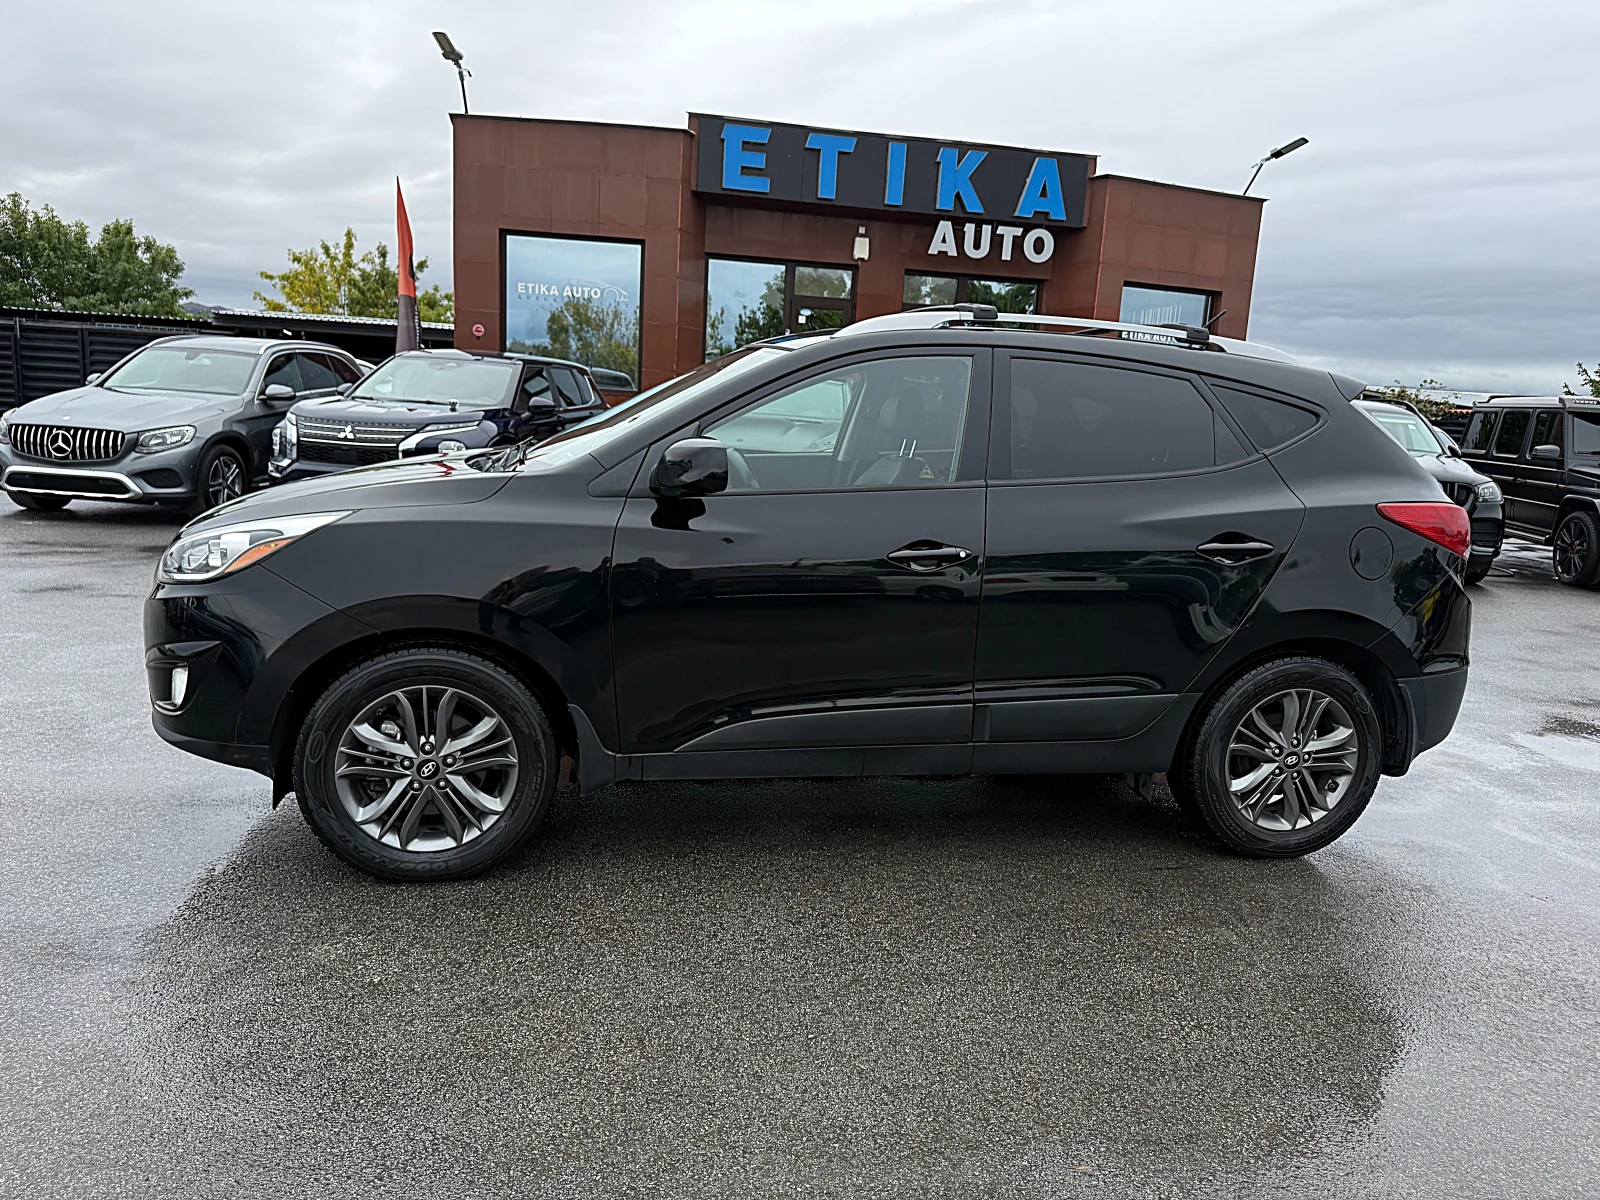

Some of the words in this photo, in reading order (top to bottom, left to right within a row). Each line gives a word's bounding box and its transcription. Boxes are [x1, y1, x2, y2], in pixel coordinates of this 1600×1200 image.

[720, 123, 1067, 221] ETIKA
[927, 220, 1055, 264] AUTO
[517, 282, 559, 296] ETIKA
[562, 285, 601, 299] AUTO
